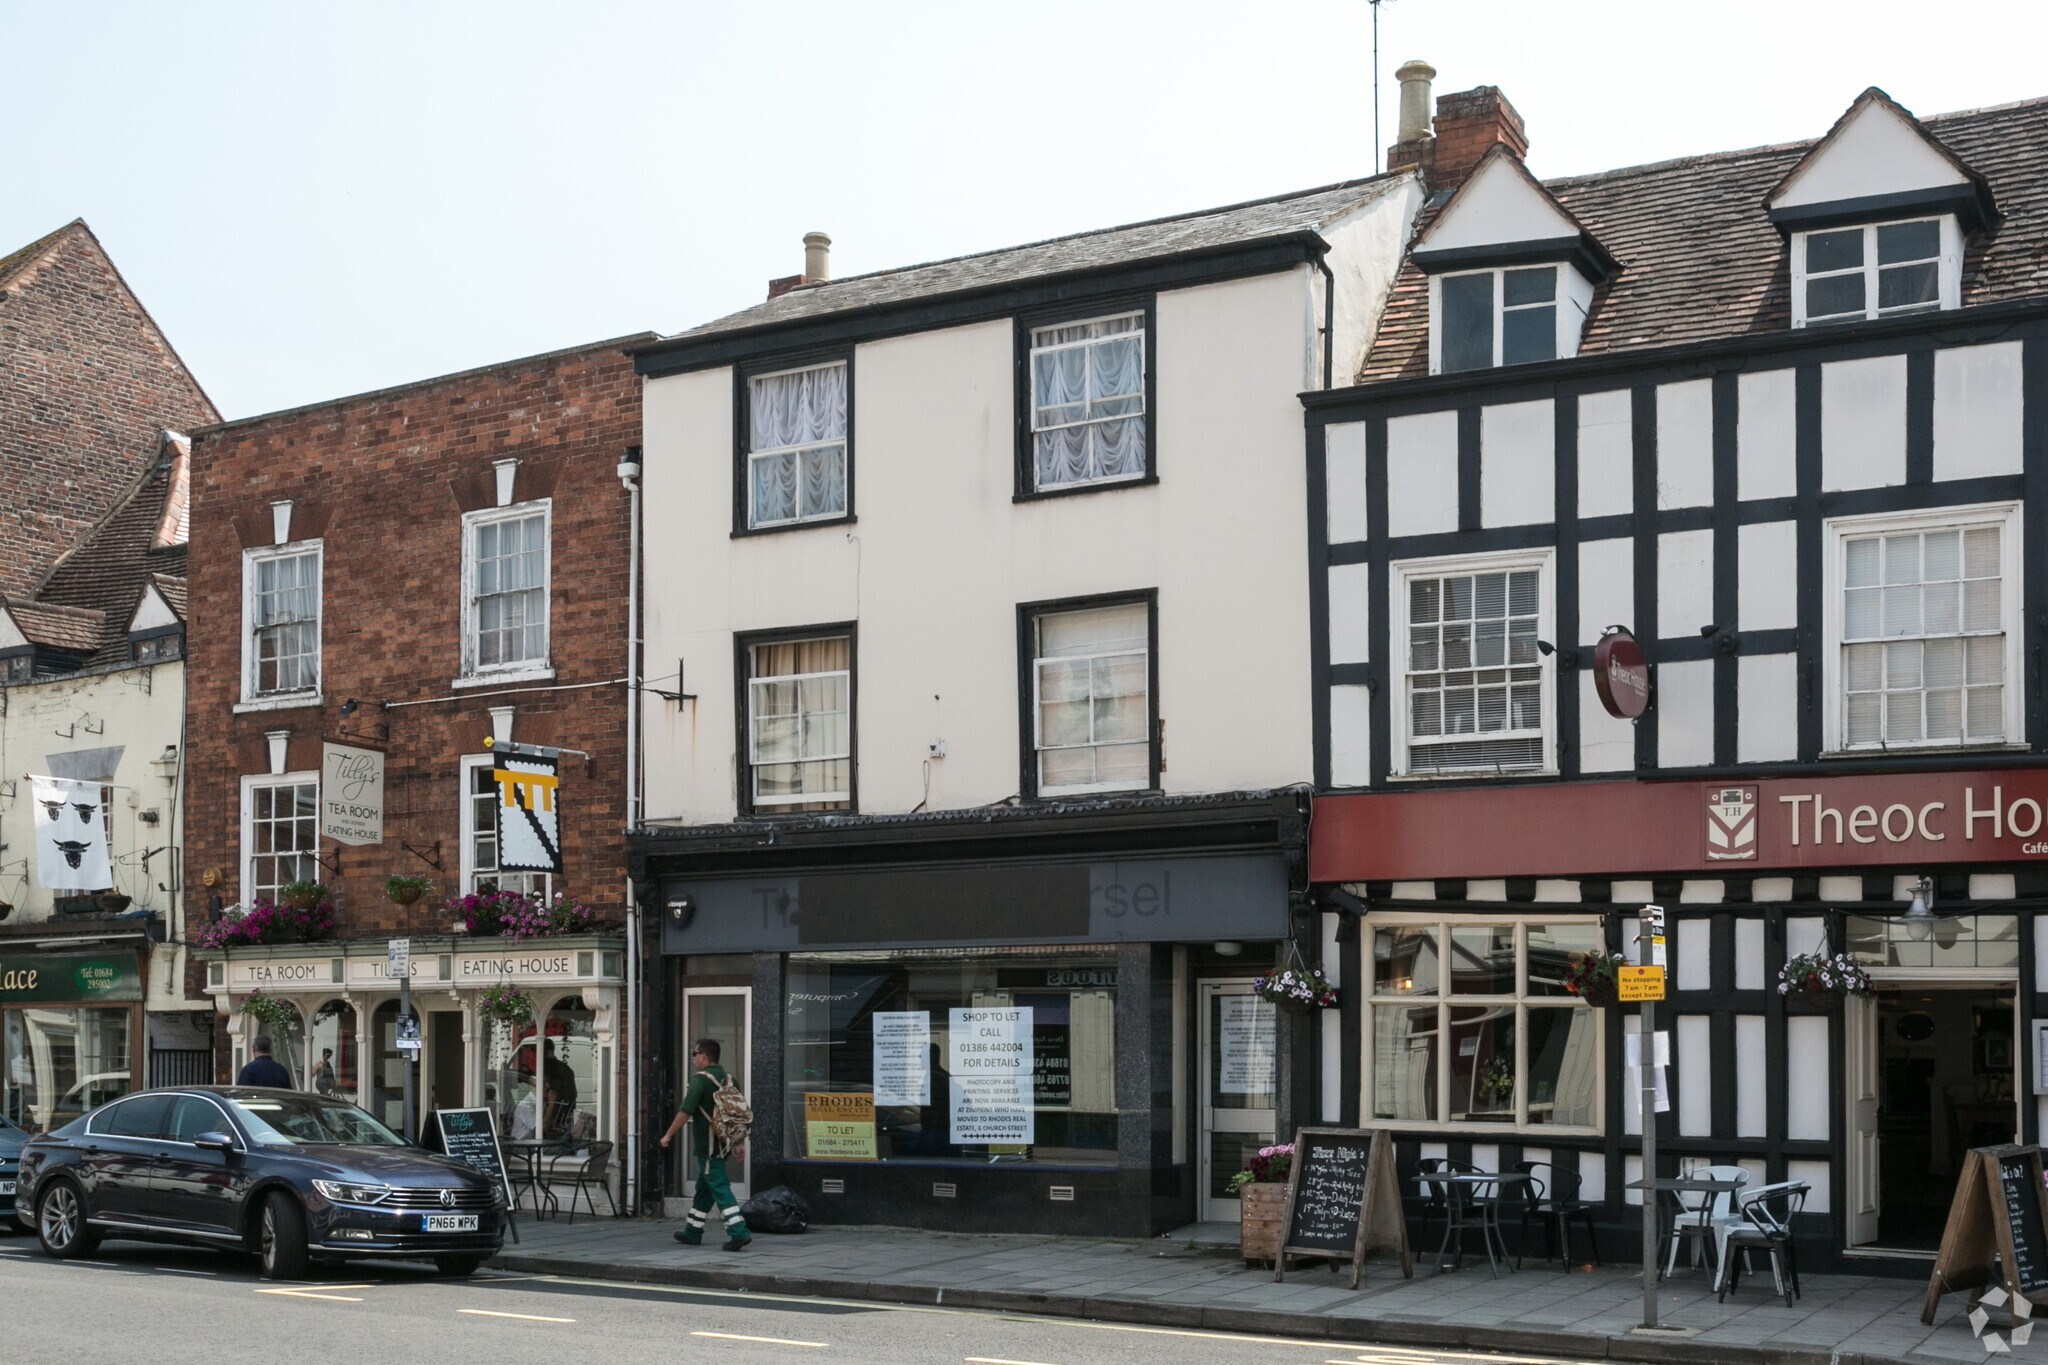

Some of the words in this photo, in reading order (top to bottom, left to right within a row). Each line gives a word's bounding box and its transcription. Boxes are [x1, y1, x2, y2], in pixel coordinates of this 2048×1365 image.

[327, 752, 380, 800] Tilly's
[328, 802, 347, 815] TEA
[350, 806, 378, 819] ROOM
[1779, 794, 1945, 845] Theoc
[1965, 786, 2048, 839] Ho
[328, 825, 352, 837] EATING
[354, 830, 378, 840] HOUSE
[2022, 841, 2048, 854] Café
[94, 967, 113, 977] 01684
[463, 959, 514, 975] EATING
[520, 957, 569, 973] HOUSE
[248, 966, 272, 980] TEA
[278, 965, 315, 979] ROOM
[88, 980, 111, 989] 295002
[963, 1012, 987, 1021] SHOP
[990, 1012, 1002, 1021] TO
[1005, 1012, 1020, 1021] LET
[980, 1028, 1001, 1036] CALL
[960, 1043, 987, 1052] 01386
[990, 1043, 1023, 1052] 442004
[964, 1058, 981, 1067] FOR
[985, 1058, 1020, 1067] DETAILS
[808, 1096, 873, 1107] RHODES
[827, 1126, 838, 1134] TO
[840, 1126, 855, 1134] LET
[429, 1217, 455, 1229] PN66
[458, 1216, 476, 1228] WPK
